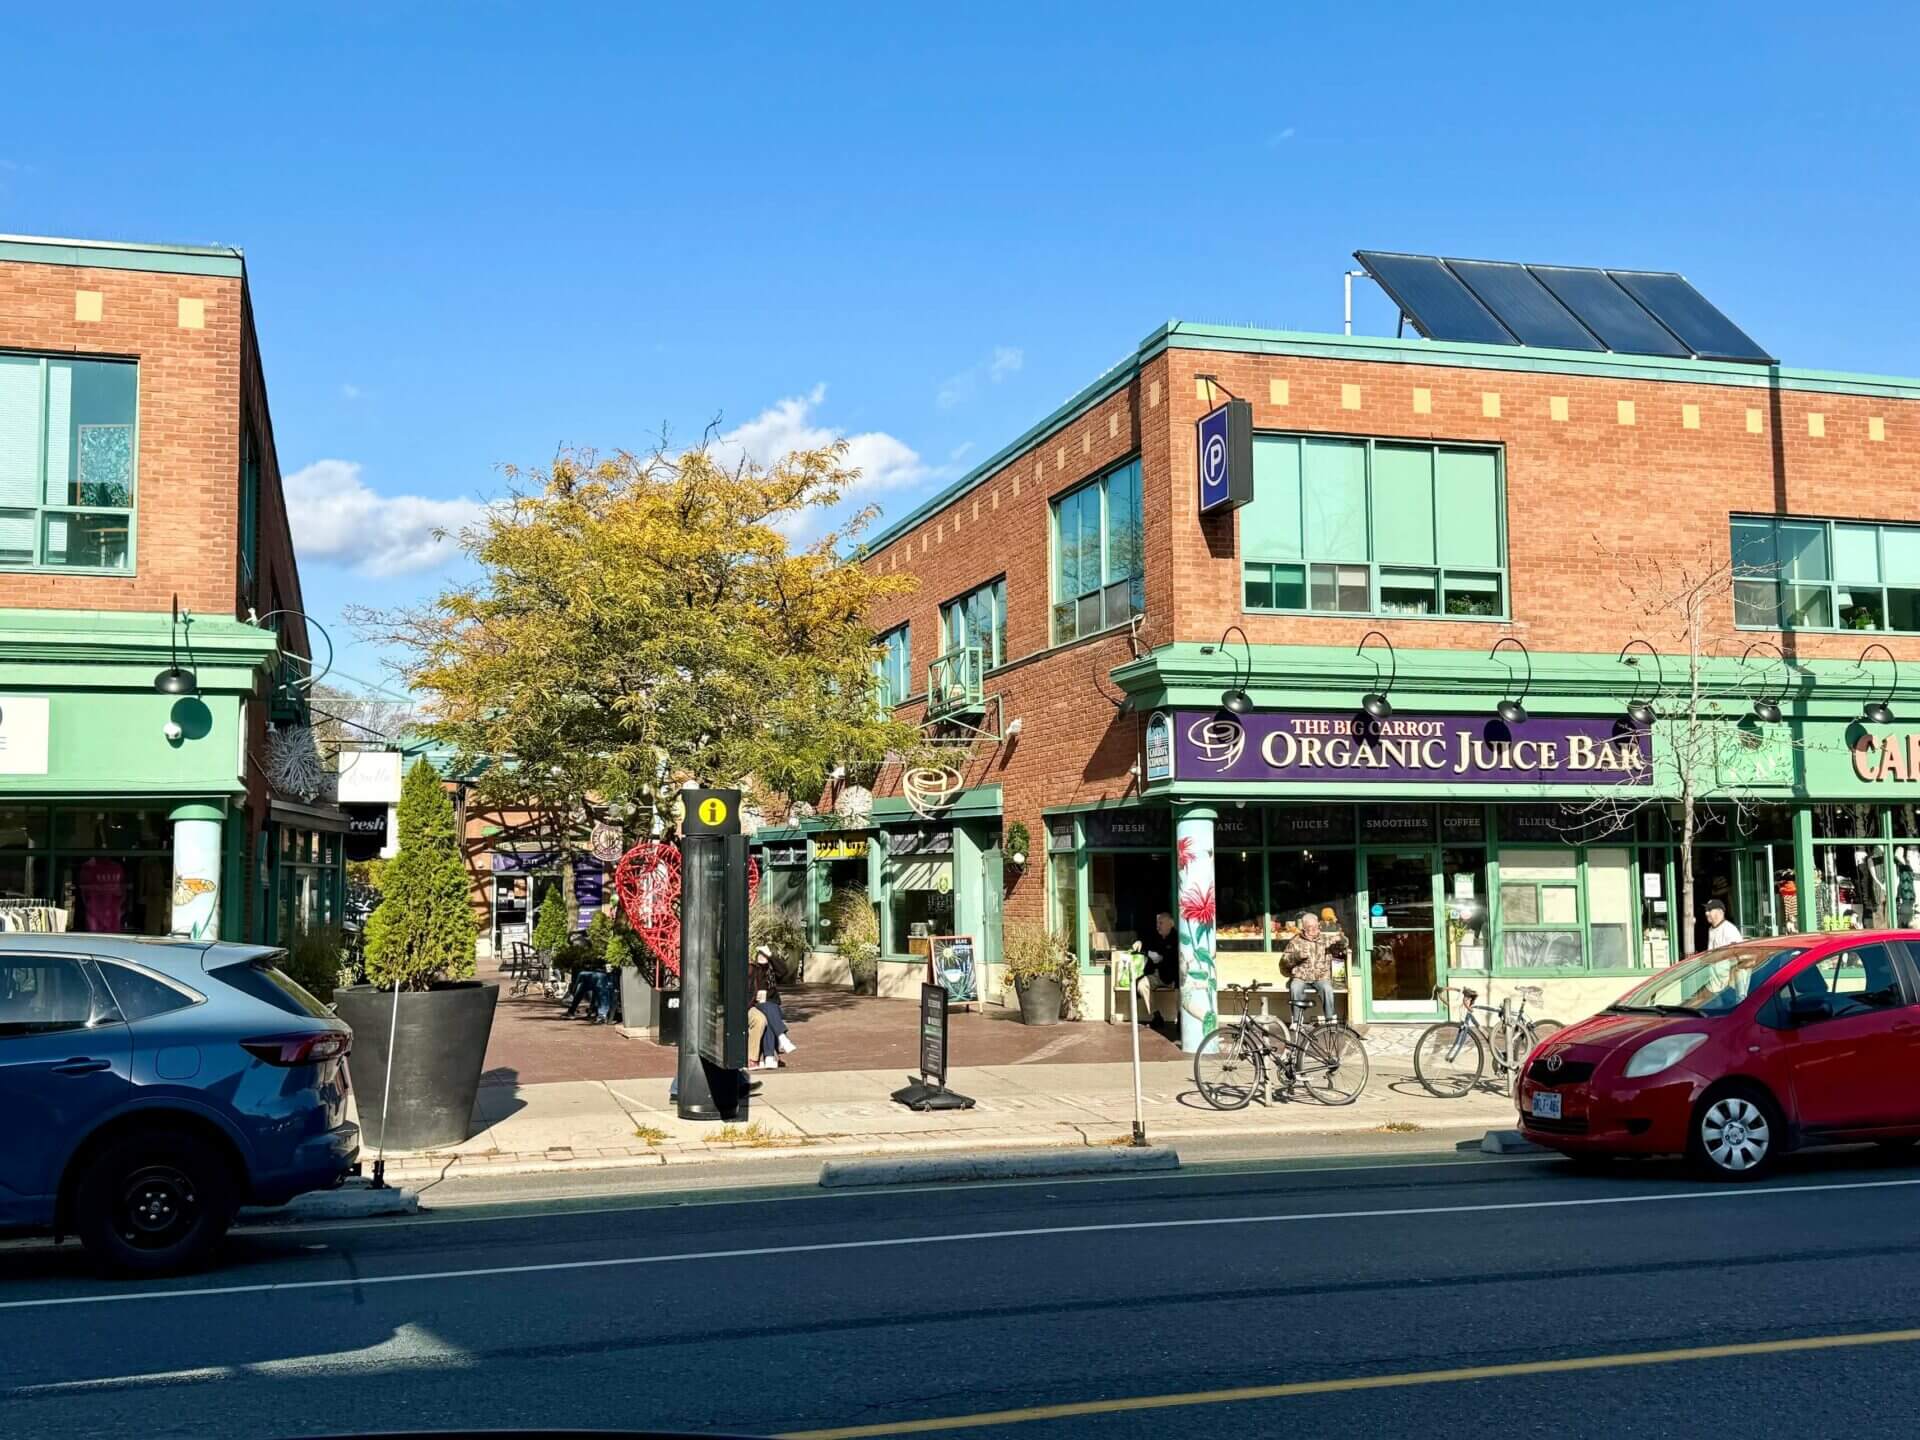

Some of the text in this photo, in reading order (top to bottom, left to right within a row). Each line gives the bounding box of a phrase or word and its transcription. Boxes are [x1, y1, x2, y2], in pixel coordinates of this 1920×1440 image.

[1291, 719, 1445, 737] THE BIG CARROT
[1261, 730, 1645, 774] ORGANIC JUICE BAR
[1111, 824, 1145, 833] FRESH
[1215, 822, 1243, 831] ANIC
[1291, 820, 1329, 831] JUICES
[1366, 819, 1428, 828] SMOOTHIES
[1443, 818, 1481, 827] COFFEE
[1519, 818, 1557, 827] ELIXIRS
